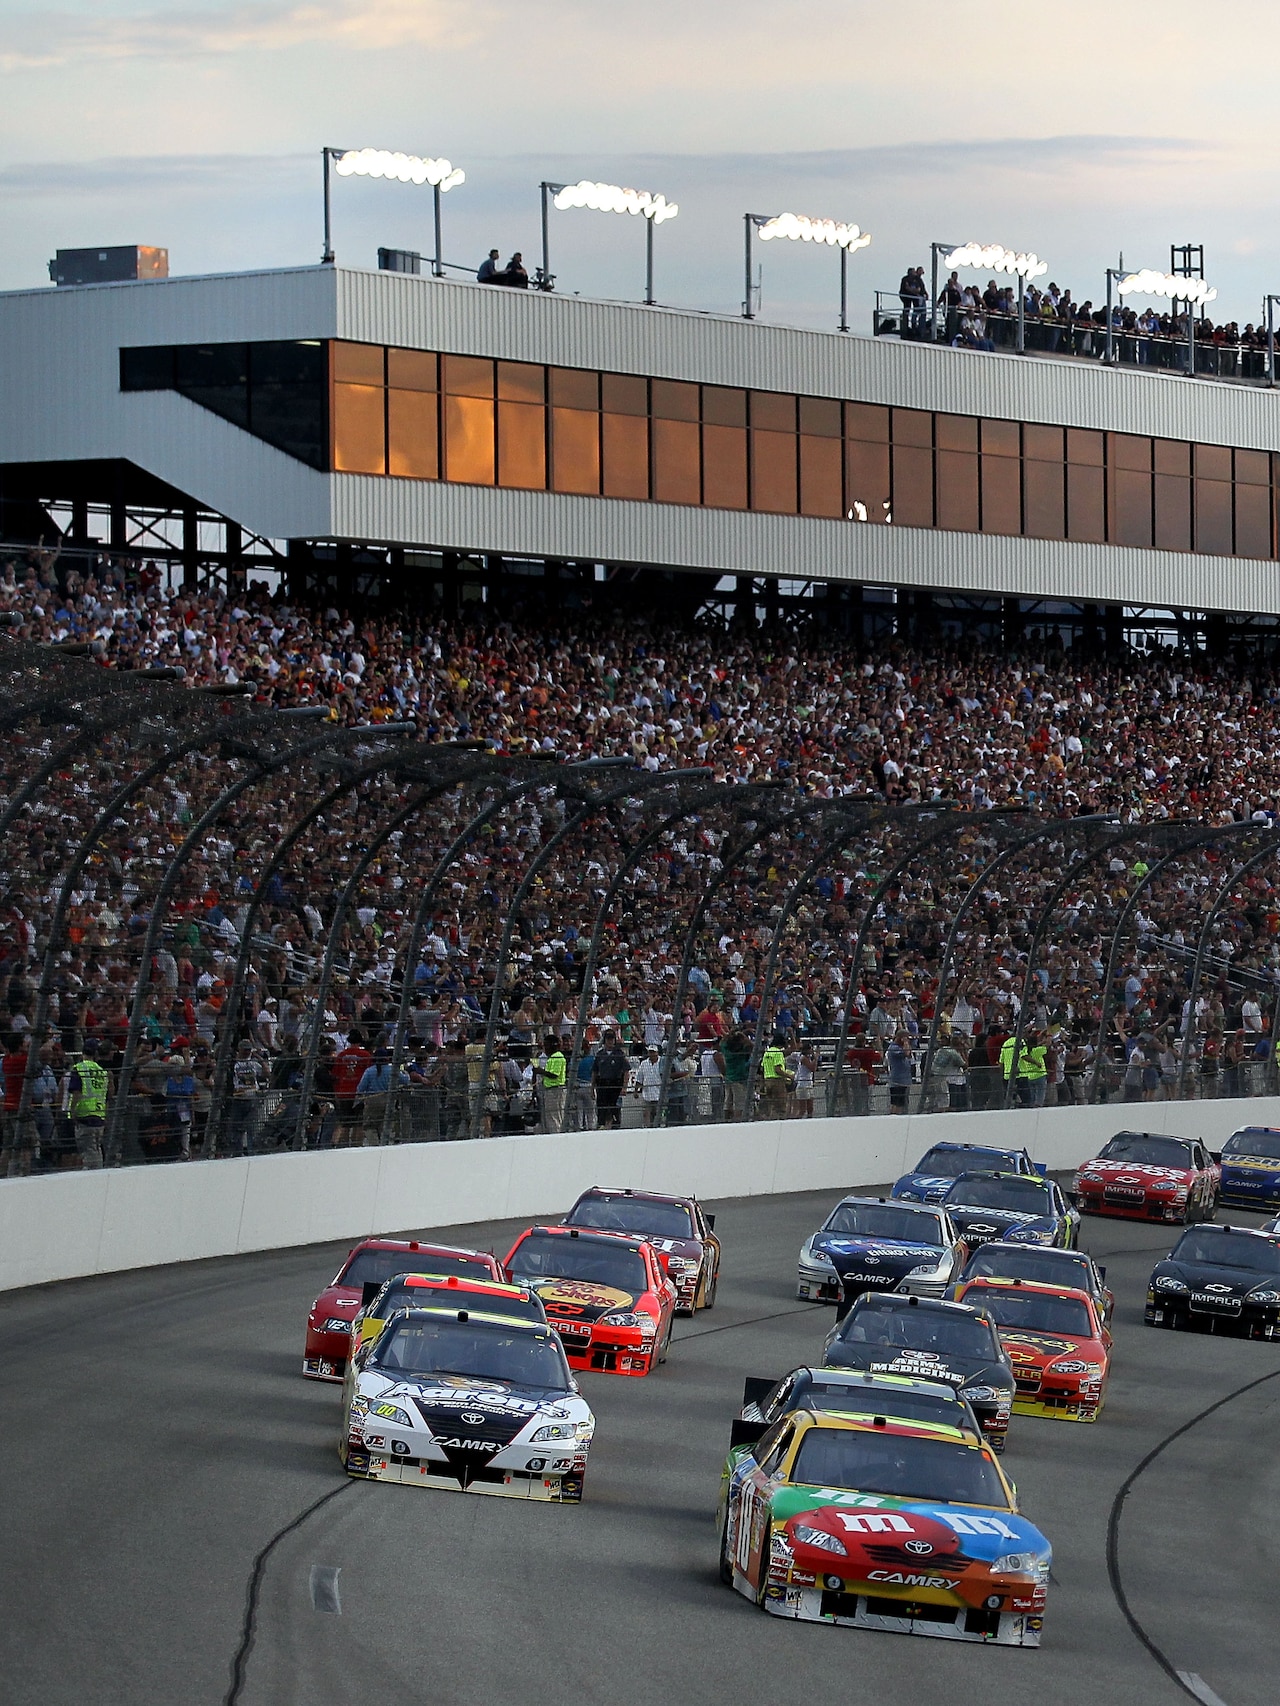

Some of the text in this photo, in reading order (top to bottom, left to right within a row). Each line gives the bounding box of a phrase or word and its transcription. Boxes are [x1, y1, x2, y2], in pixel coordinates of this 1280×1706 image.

[1104, 1185, 1146, 1197] IMPALA
[1226, 1180, 1263, 1189] CAMRY
[843, 1272, 895, 1285] CAMRY
[550, 1287, 618, 1307] Shops
[1190, 1291, 1243, 1307] IMPALA
[893, 1357, 950, 1372] ARMY
[870, 1363, 965, 1384] MEDICINE
[376, 1381, 571, 1420] Aaron's
[377, 1404, 397, 1417] 00
[430, 1435, 512, 1453] CAMRY
[835, 1511, 916, 1534] m
[932, 1510, 1021, 1540] m
[805, 1530, 830, 1547] 18
[866, 1569, 962, 1590] CAMRY
